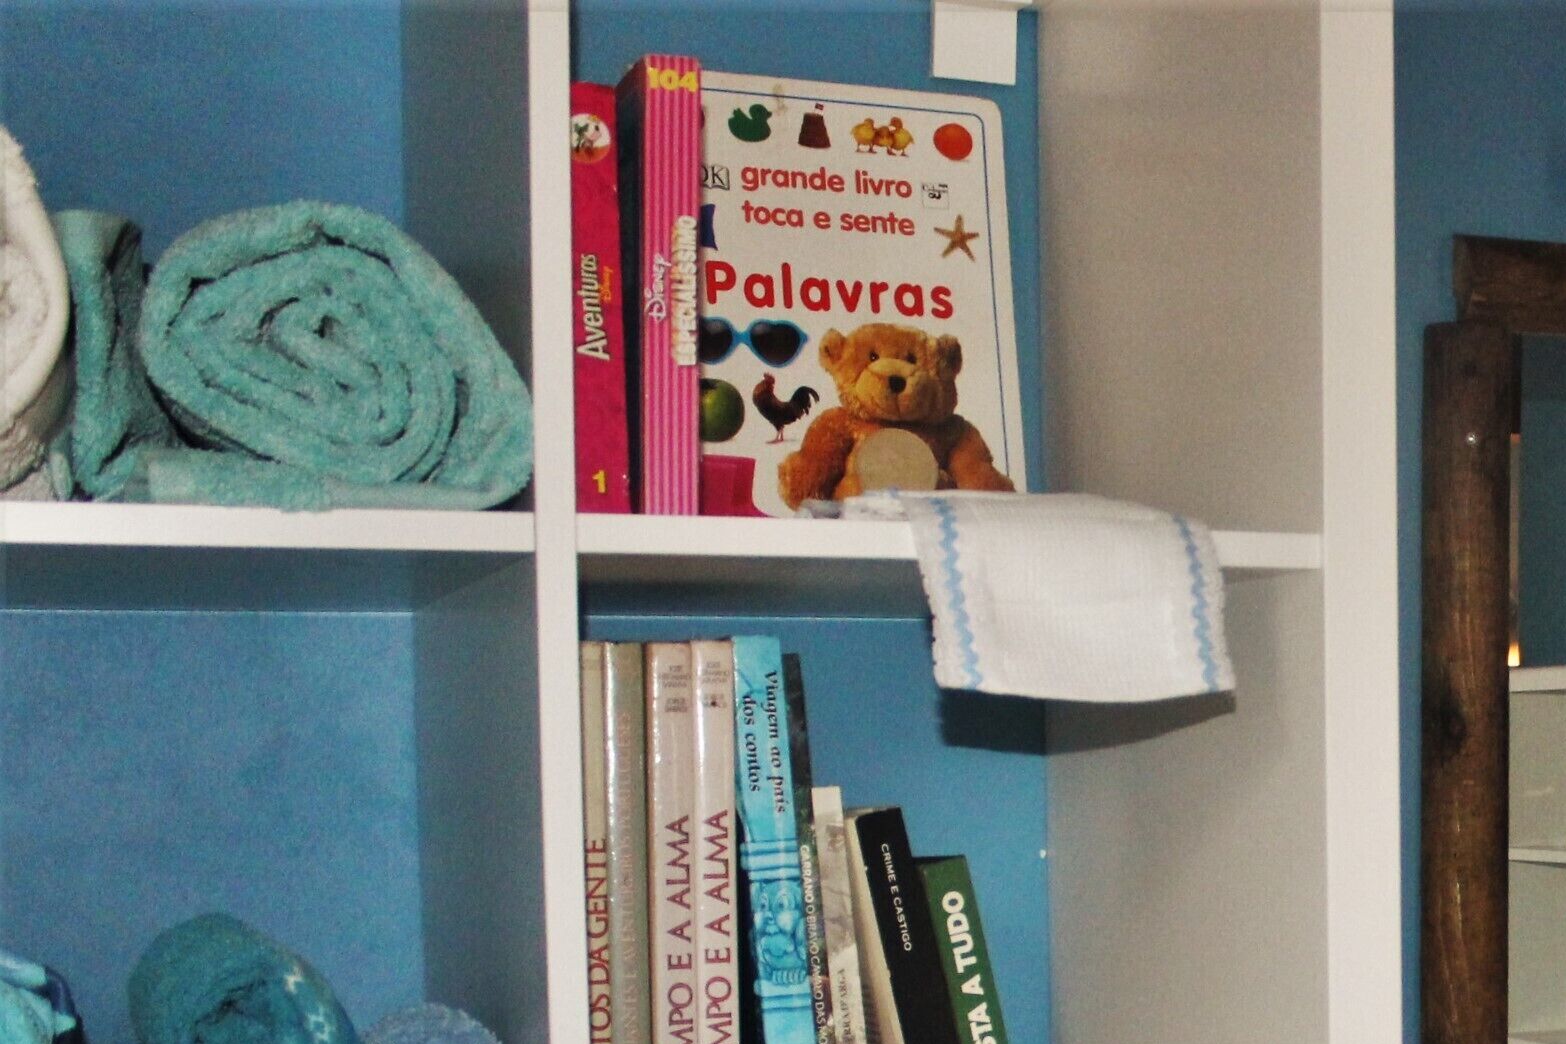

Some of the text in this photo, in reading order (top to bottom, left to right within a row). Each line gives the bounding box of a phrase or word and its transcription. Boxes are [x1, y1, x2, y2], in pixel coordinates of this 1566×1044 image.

[647, 67, 699, 93] 104
[740, 166, 846, 192] grande
[855, 169, 913, 198] livro
[741, 200, 916, 236] toca e sente
[576, 253, 611, 361] Aventuras
[644, 252, 672, 322] Disney
[705, 260, 954, 319] Palavras
[592, 470, 606, 493] 1
[760, 670, 780, 739] Viagem
[742, 694, 761, 792] dos contos
[769, 746, 782, 770] ao
[665, 814, 691, 910] ALMA
[703, 810, 730, 905] ALMA
[800, 844, 814, 903] GARRANO
[586, 838, 609, 940] GENTE
[881, 843, 912, 951] CRIME E CASTIGO
[705, 914, 731, 936] A
[805, 904, 815, 915] O
[667, 919, 691, 942] A
[806, 915, 819, 957] BRAVO
[942, 890, 977, 974] TUDO
[588, 945, 612, 985] DA
[667, 952, 693, 970] E
[705, 947, 731, 964] E
[961, 973, 984, 996] A
[814, 1002, 826, 1025] DAS
